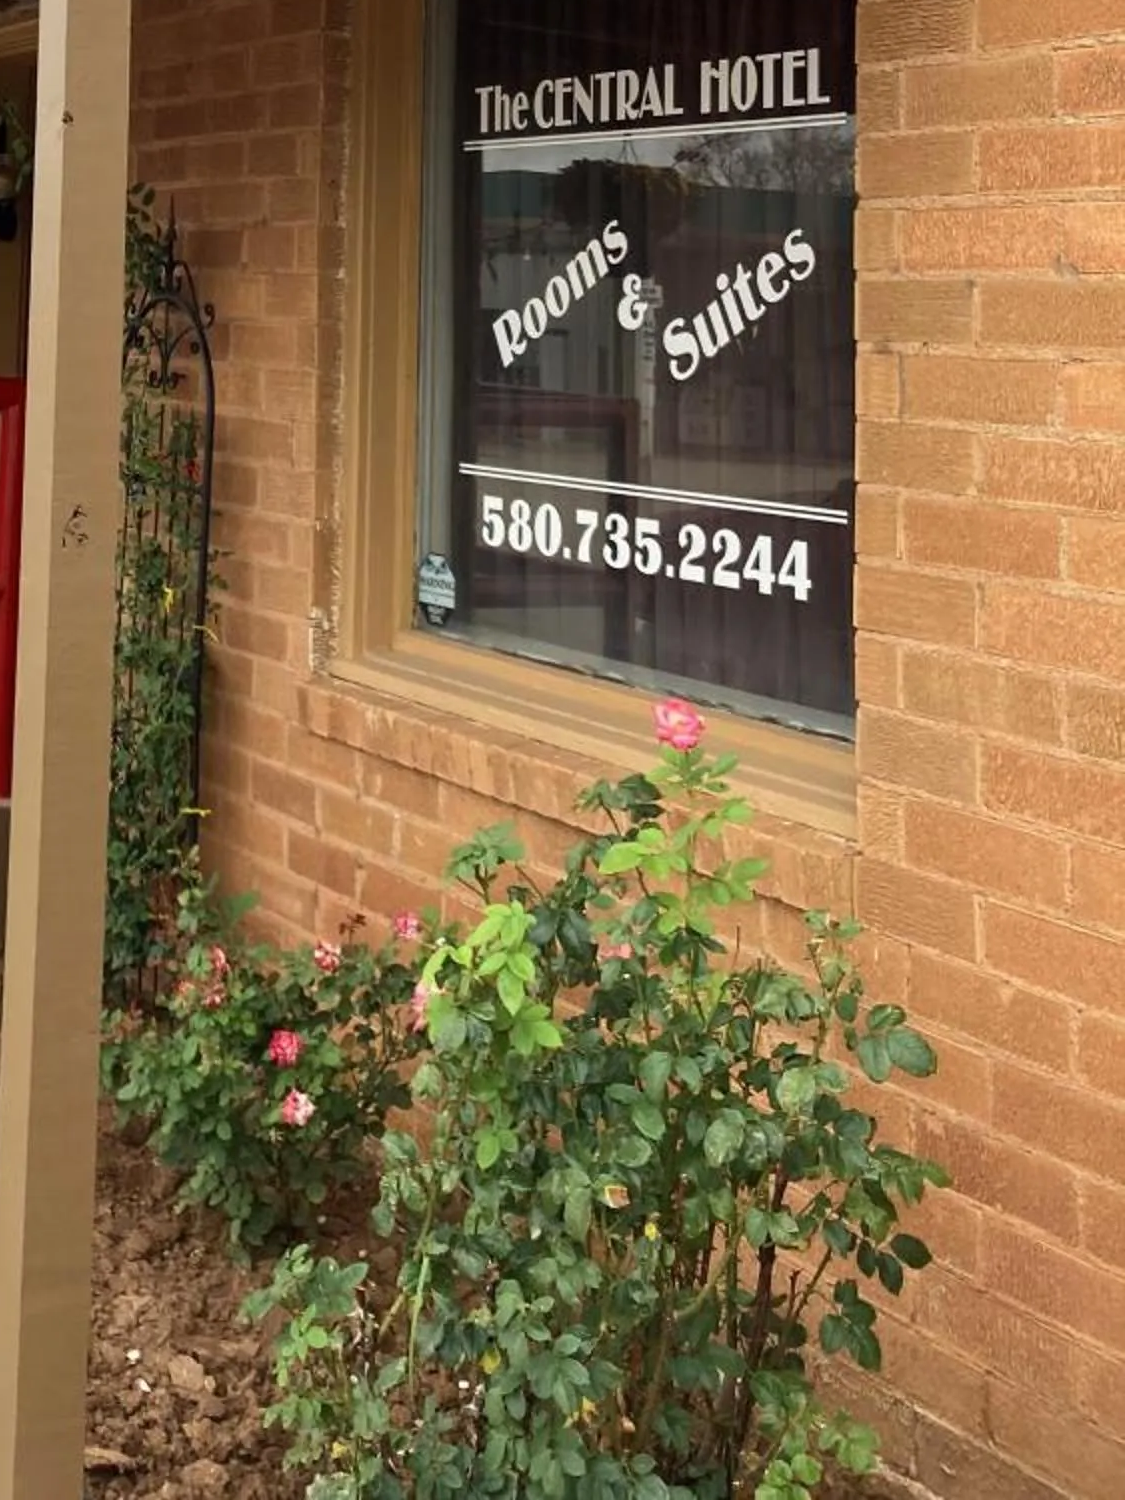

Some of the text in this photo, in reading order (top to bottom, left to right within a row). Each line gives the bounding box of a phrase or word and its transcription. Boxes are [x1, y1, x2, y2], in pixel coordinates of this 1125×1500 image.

[475, 47, 830, 135] The CENTRAL HOTEL
[491, 218, 817, 381] Rooms & Suites
[481, 495, 813, 603] 580.735.2244
